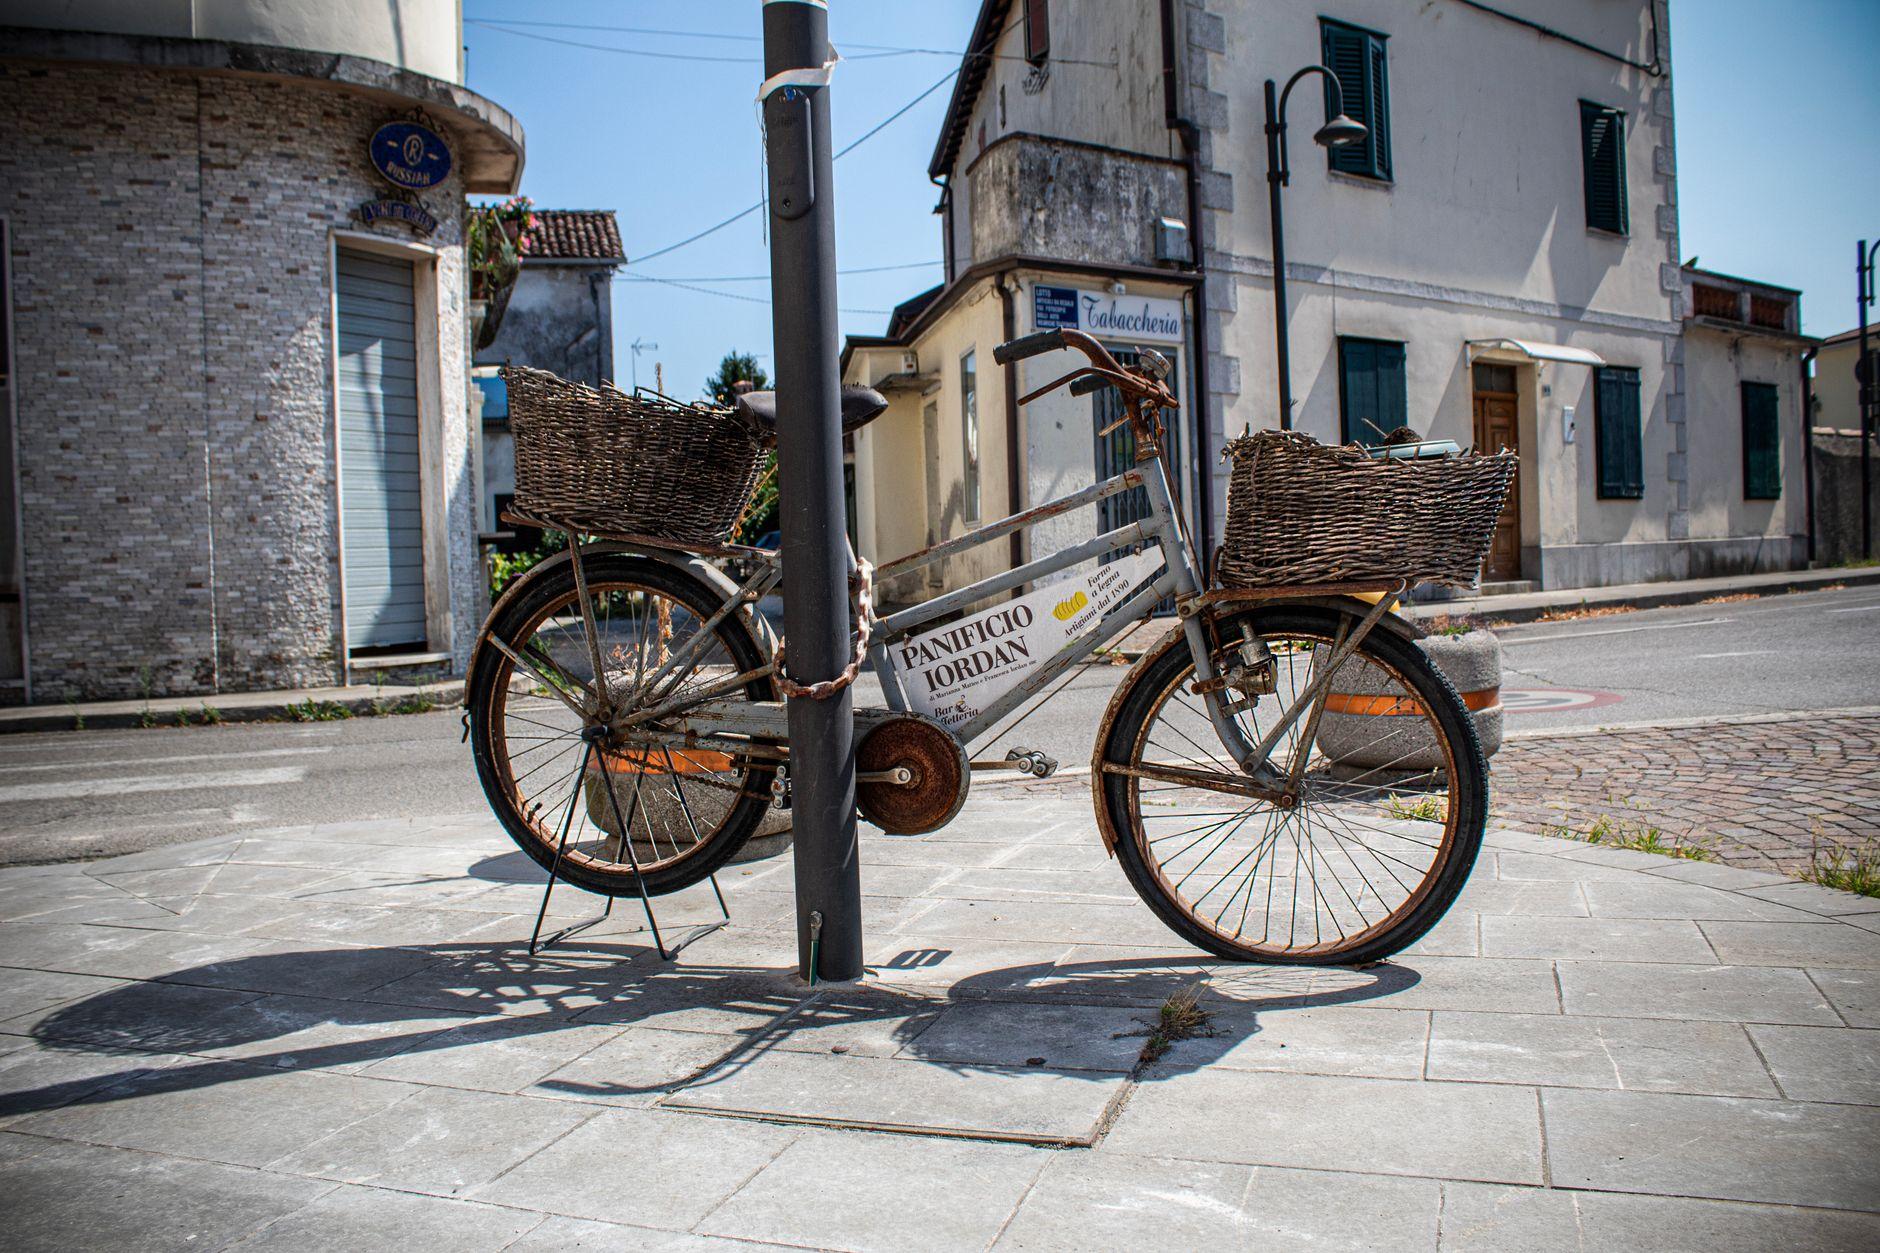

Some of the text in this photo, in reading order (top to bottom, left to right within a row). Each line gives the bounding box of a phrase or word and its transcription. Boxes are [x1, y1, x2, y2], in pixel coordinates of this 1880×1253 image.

[386, 161, 430, 185] RUSSIAN
[1082, 295, 1179, 335] Tabaccheria
[1087, 565, 1111, 587] Forno
[1091, 571, 1120, 598] a legna
[1064, 579, 1129, 638] Artigiani dal 1890
[899, 604, 1033, 671] PANIFICIO
[923, 635, 1030, 692] IORDAN
[936, 688, 961, 698] Marianna
[984, 669, 1009, 681] Francesca
[934, 705, 953, 718] Bar
